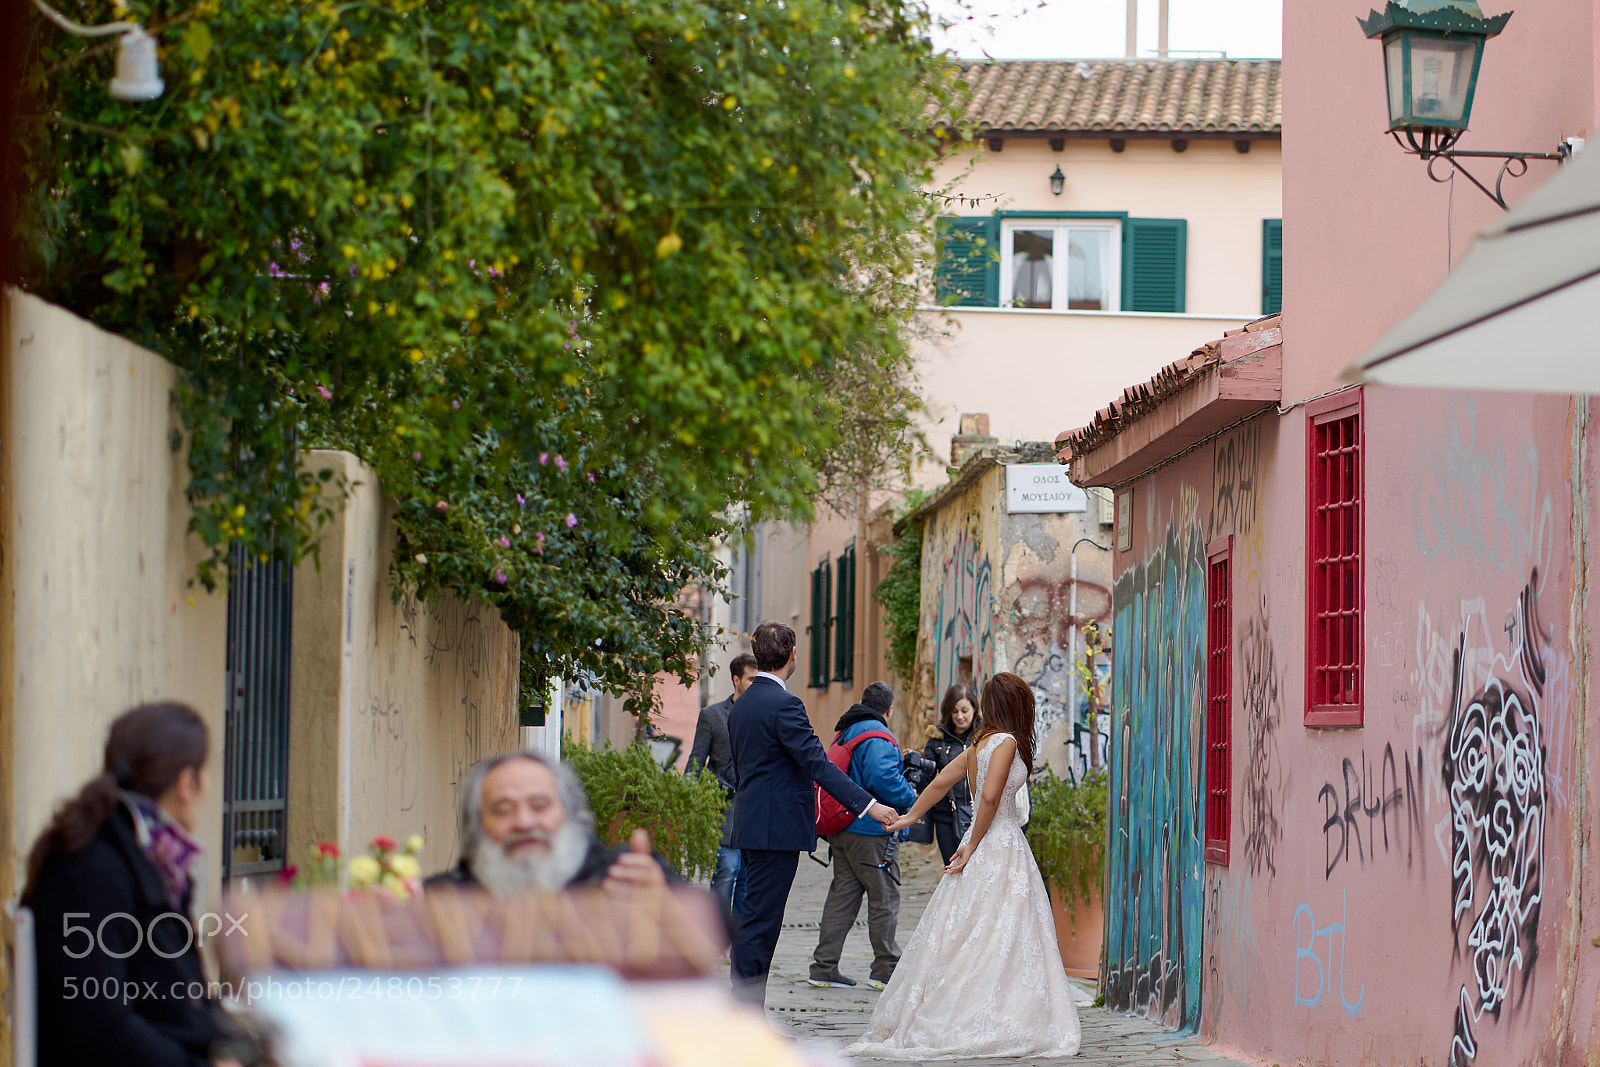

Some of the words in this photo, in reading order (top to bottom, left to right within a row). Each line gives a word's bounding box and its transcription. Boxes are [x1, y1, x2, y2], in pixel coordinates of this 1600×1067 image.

[1032, 475, 1061, 484] ΟΔΟΣ
[1021, 492, 1072, 502] ΜΟΥΣΑΙΟΥ
[1317, 741, 1427, 882] BRYAN
